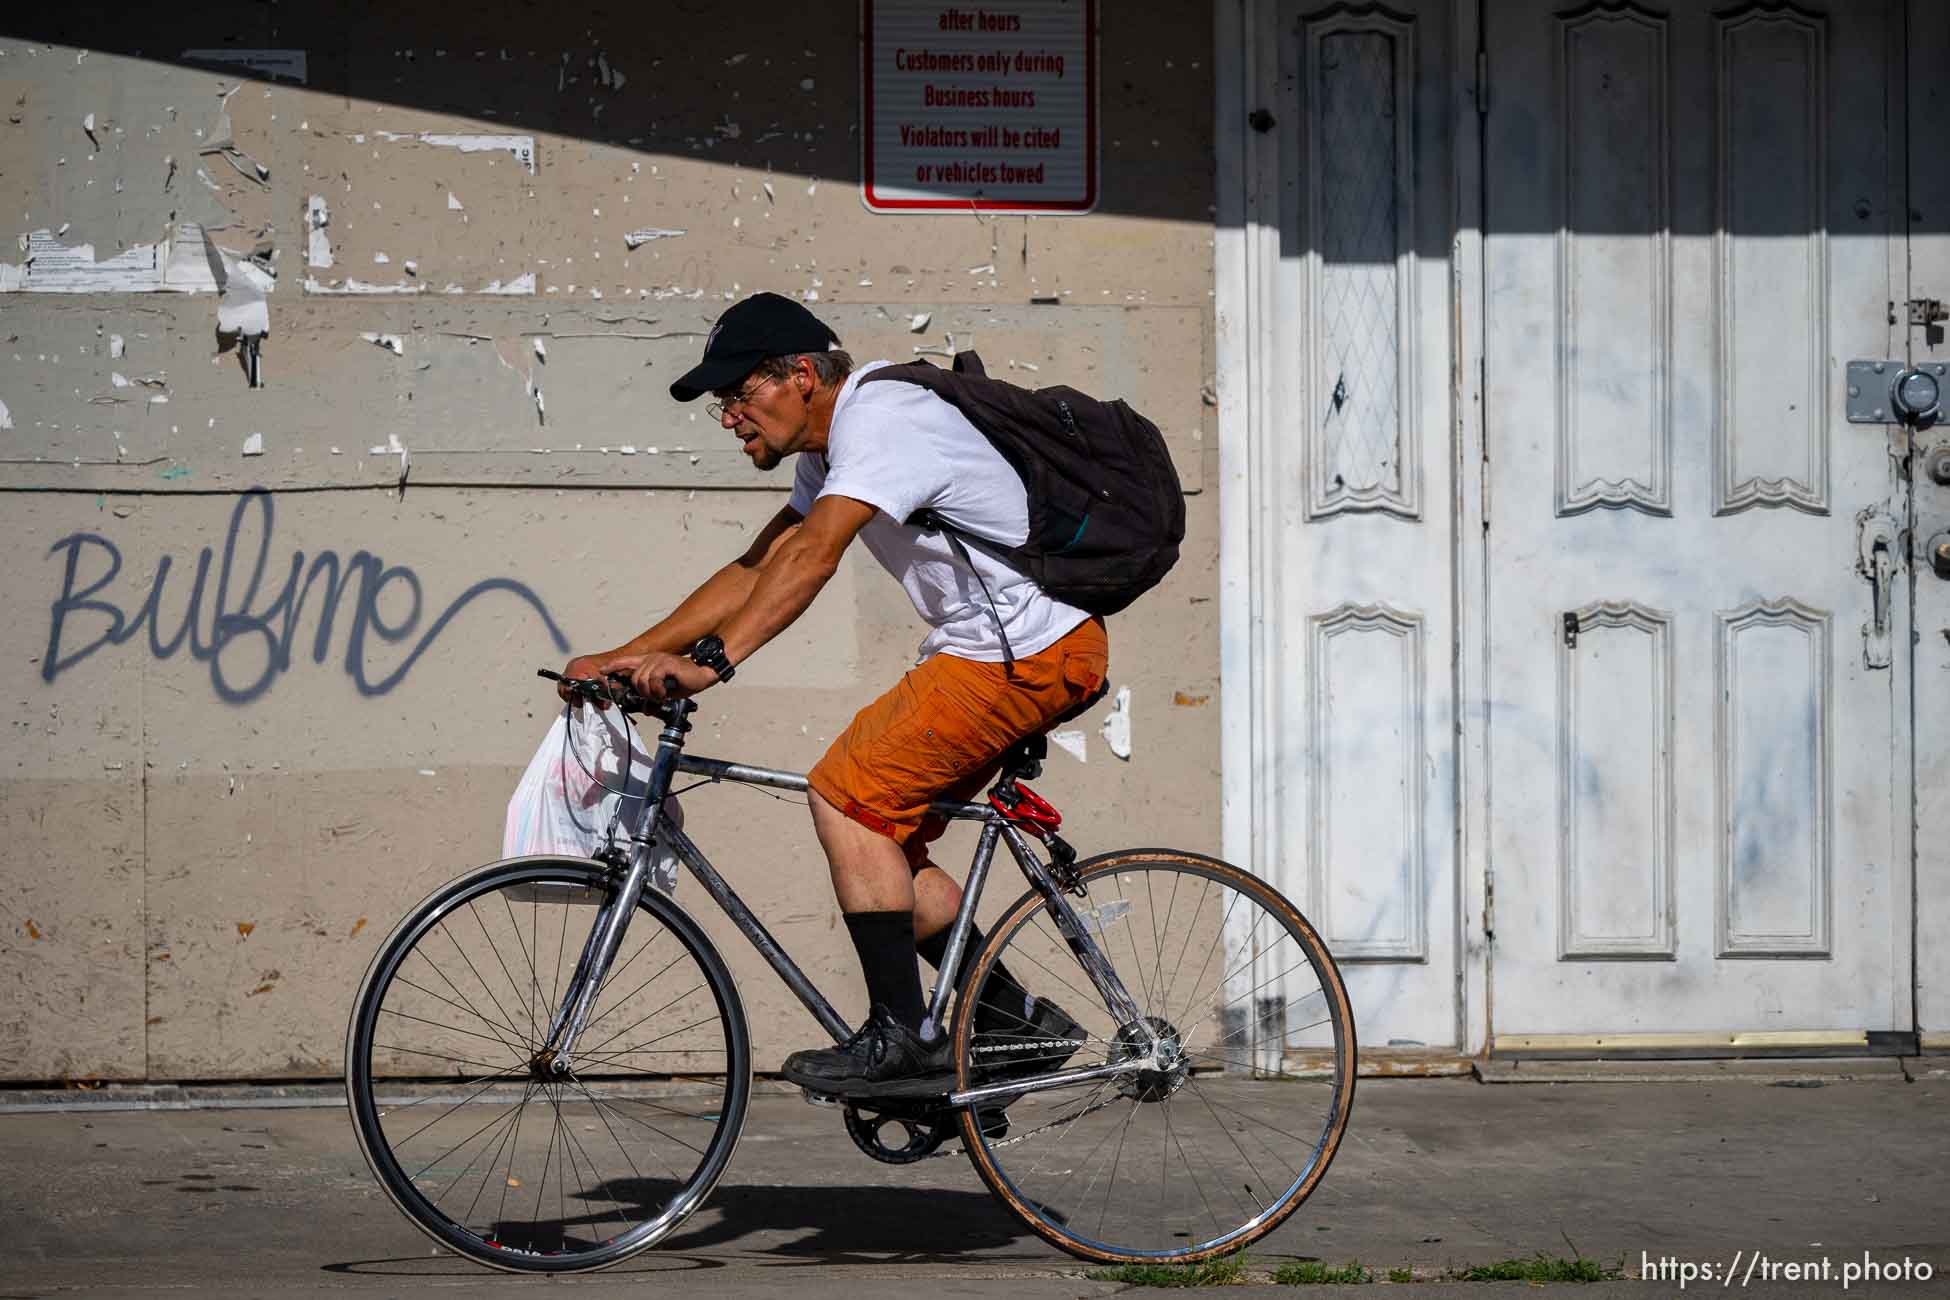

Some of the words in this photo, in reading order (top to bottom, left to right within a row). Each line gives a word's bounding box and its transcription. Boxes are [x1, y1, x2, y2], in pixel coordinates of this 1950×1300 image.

[939, 9, 974, 31] after
[979, 10, 1021, 31] hours
[896, 49, 974, 72] Customers
[977, 51, 1010, 76] only
[1015, 50, 1064, 78] during
[924, 85, 989, 108] Business
[992, 86, 1035, 108] hours
[901, 125, 968, 148] Violators
[971, 126, 999, 148] will
[1003, 127, 1020, 148] be
[1024, 126, 1061, 149] cited
[917, 165, 933, 183] or
[937, 161, 997, 184] vehicles
[1001, 162, 1044, 184] towed
